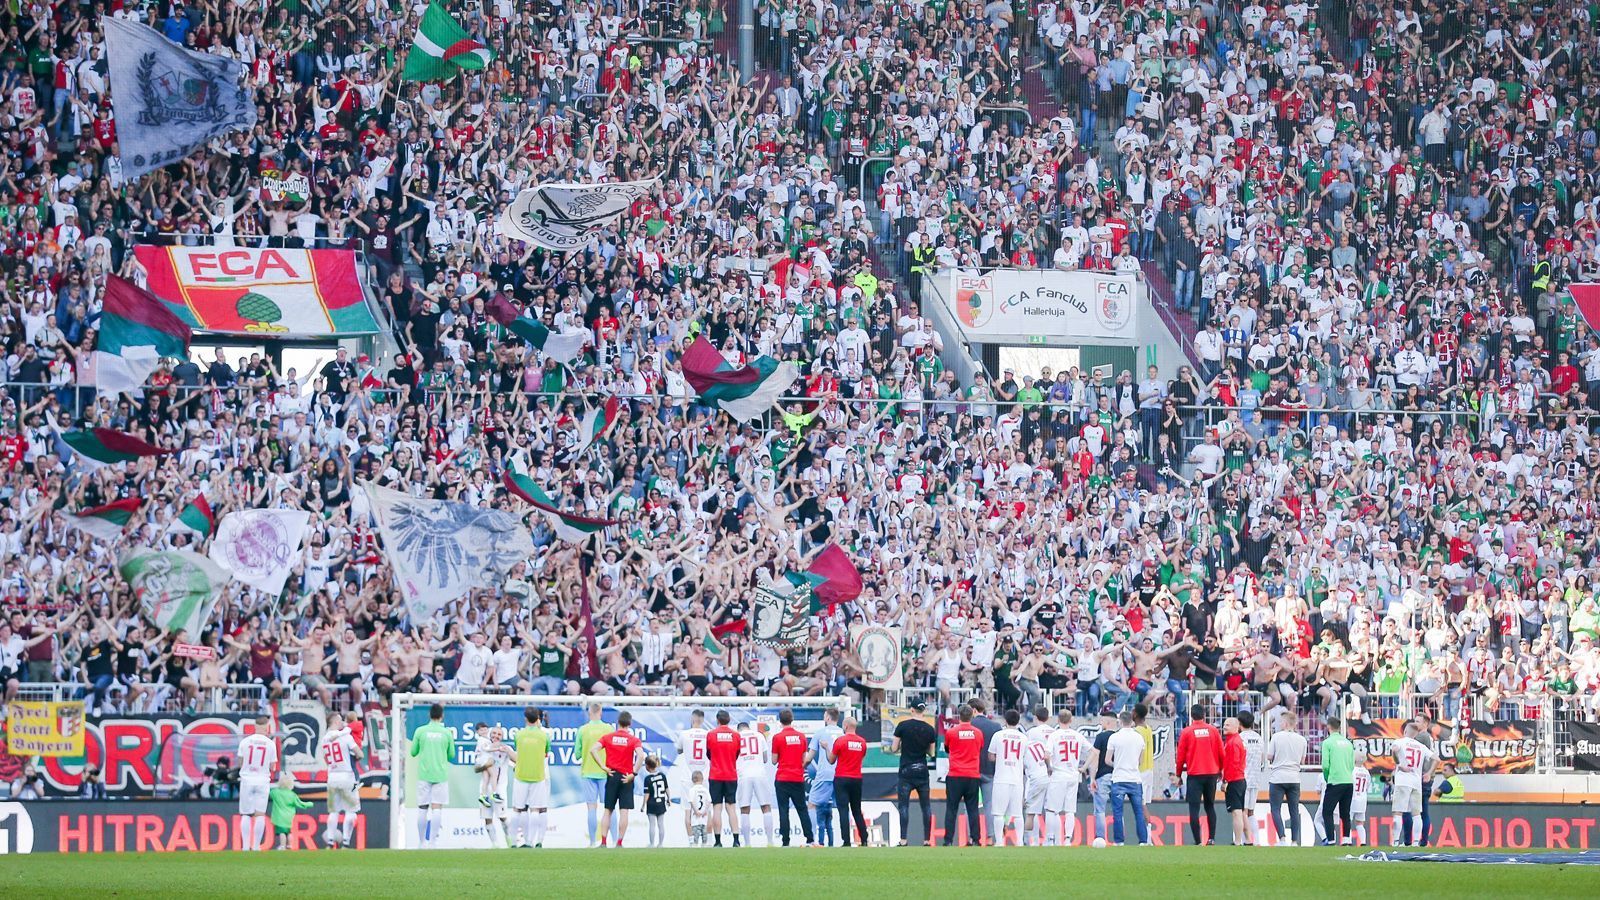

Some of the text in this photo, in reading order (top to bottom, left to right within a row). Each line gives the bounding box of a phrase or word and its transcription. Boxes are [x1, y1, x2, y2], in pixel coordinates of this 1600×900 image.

[188, 250, 299, 279] FCA
[961, 278, 988, 290] FCA
[1097, 282, 1128, 295] FCA
[1000, 287, 1088, 314] FCA Fanclub
[1024, 306, 1065, 317] Hallerluja
[755, 592, 779, 610] FCA
[12, 704, 48, 719] Frei
[12, 738, 73, 753] Bayern
[322, 742, 343, 764] 28
[693, 740, 703, 760] 6
[740, 736, 759, 757] 20
[1002, 739, 1021, 760] 14
[1029, 743, 1045, 762] 10
[1060, 741, 1079, 762] 34
[1475, 739, 1535, 757] NUTS
[248, 745, 267, 767] 17
[1405, 747, 1422, 768] 31
[652, 780, 666, 799] 12
[1355, 777, 1367, 793] 31
[697, 794, 704, 810] 3
